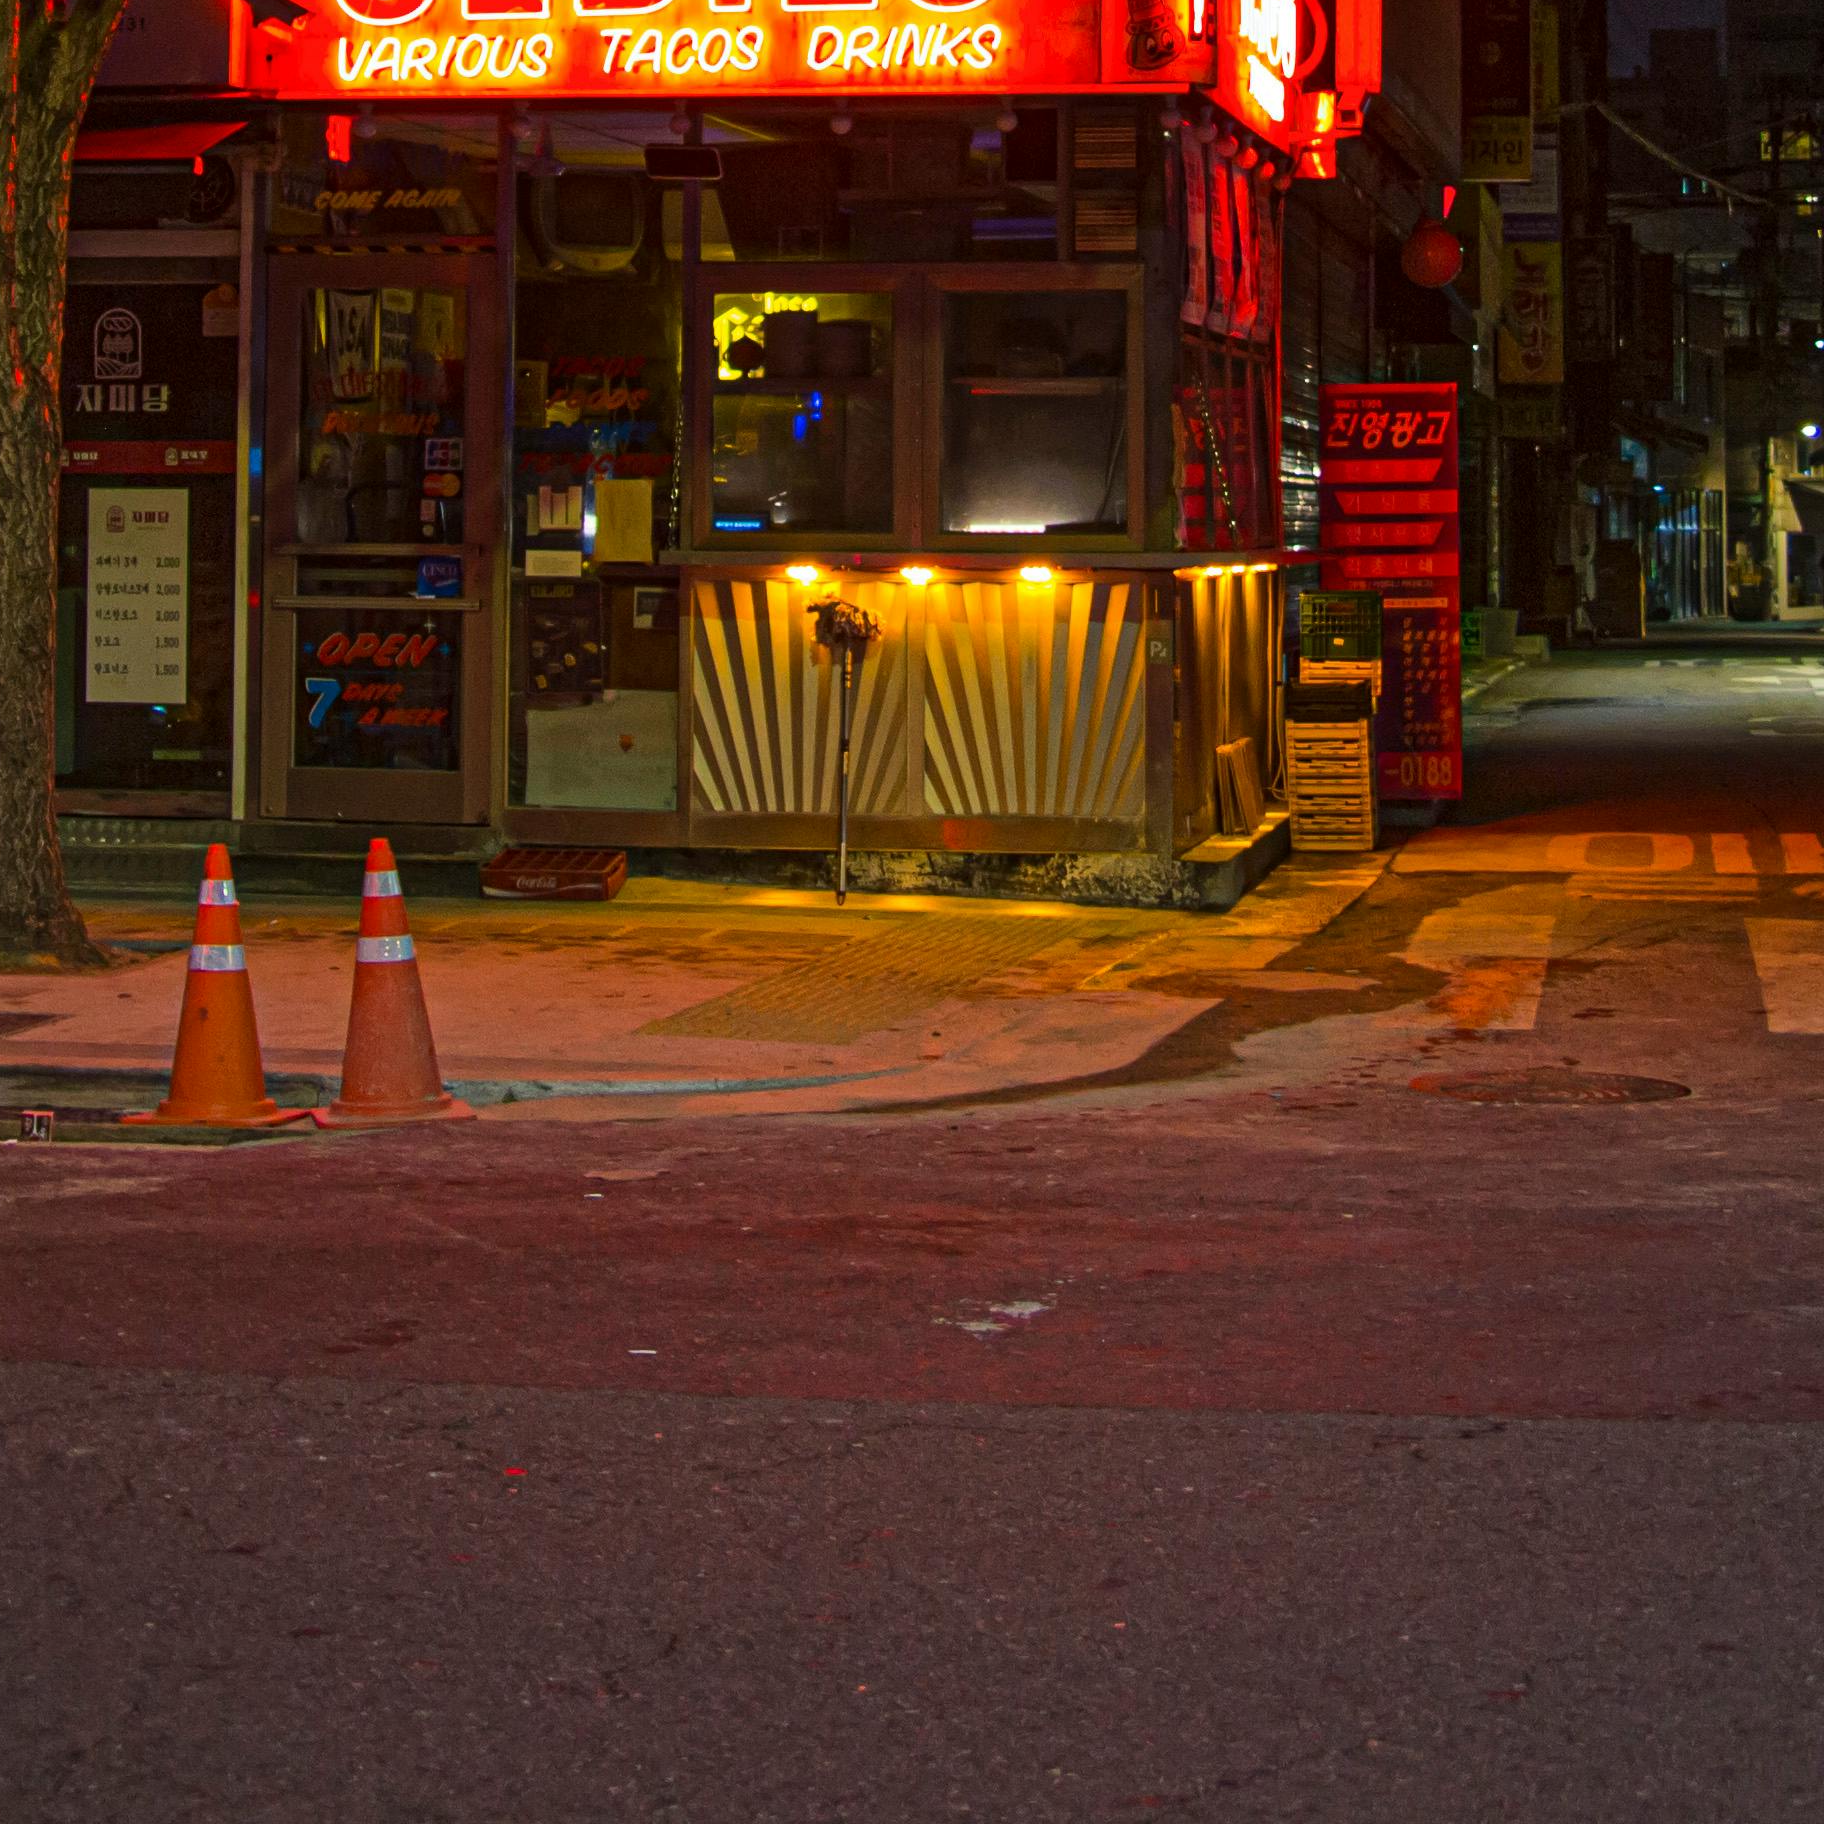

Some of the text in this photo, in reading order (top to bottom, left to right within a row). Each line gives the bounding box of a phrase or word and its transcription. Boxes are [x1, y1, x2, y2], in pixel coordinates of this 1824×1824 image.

[337, 23, 1002, 82] VARIOUS TACOS DRINKS
[383, 188, 462, 208] AGAIN
[74, 382, 173, 413] 자미당
[1325, 411, 1451, 450] 진영광고
[316, 631, 439, 669] OPEN
[304, 677, 343, 730] 7
